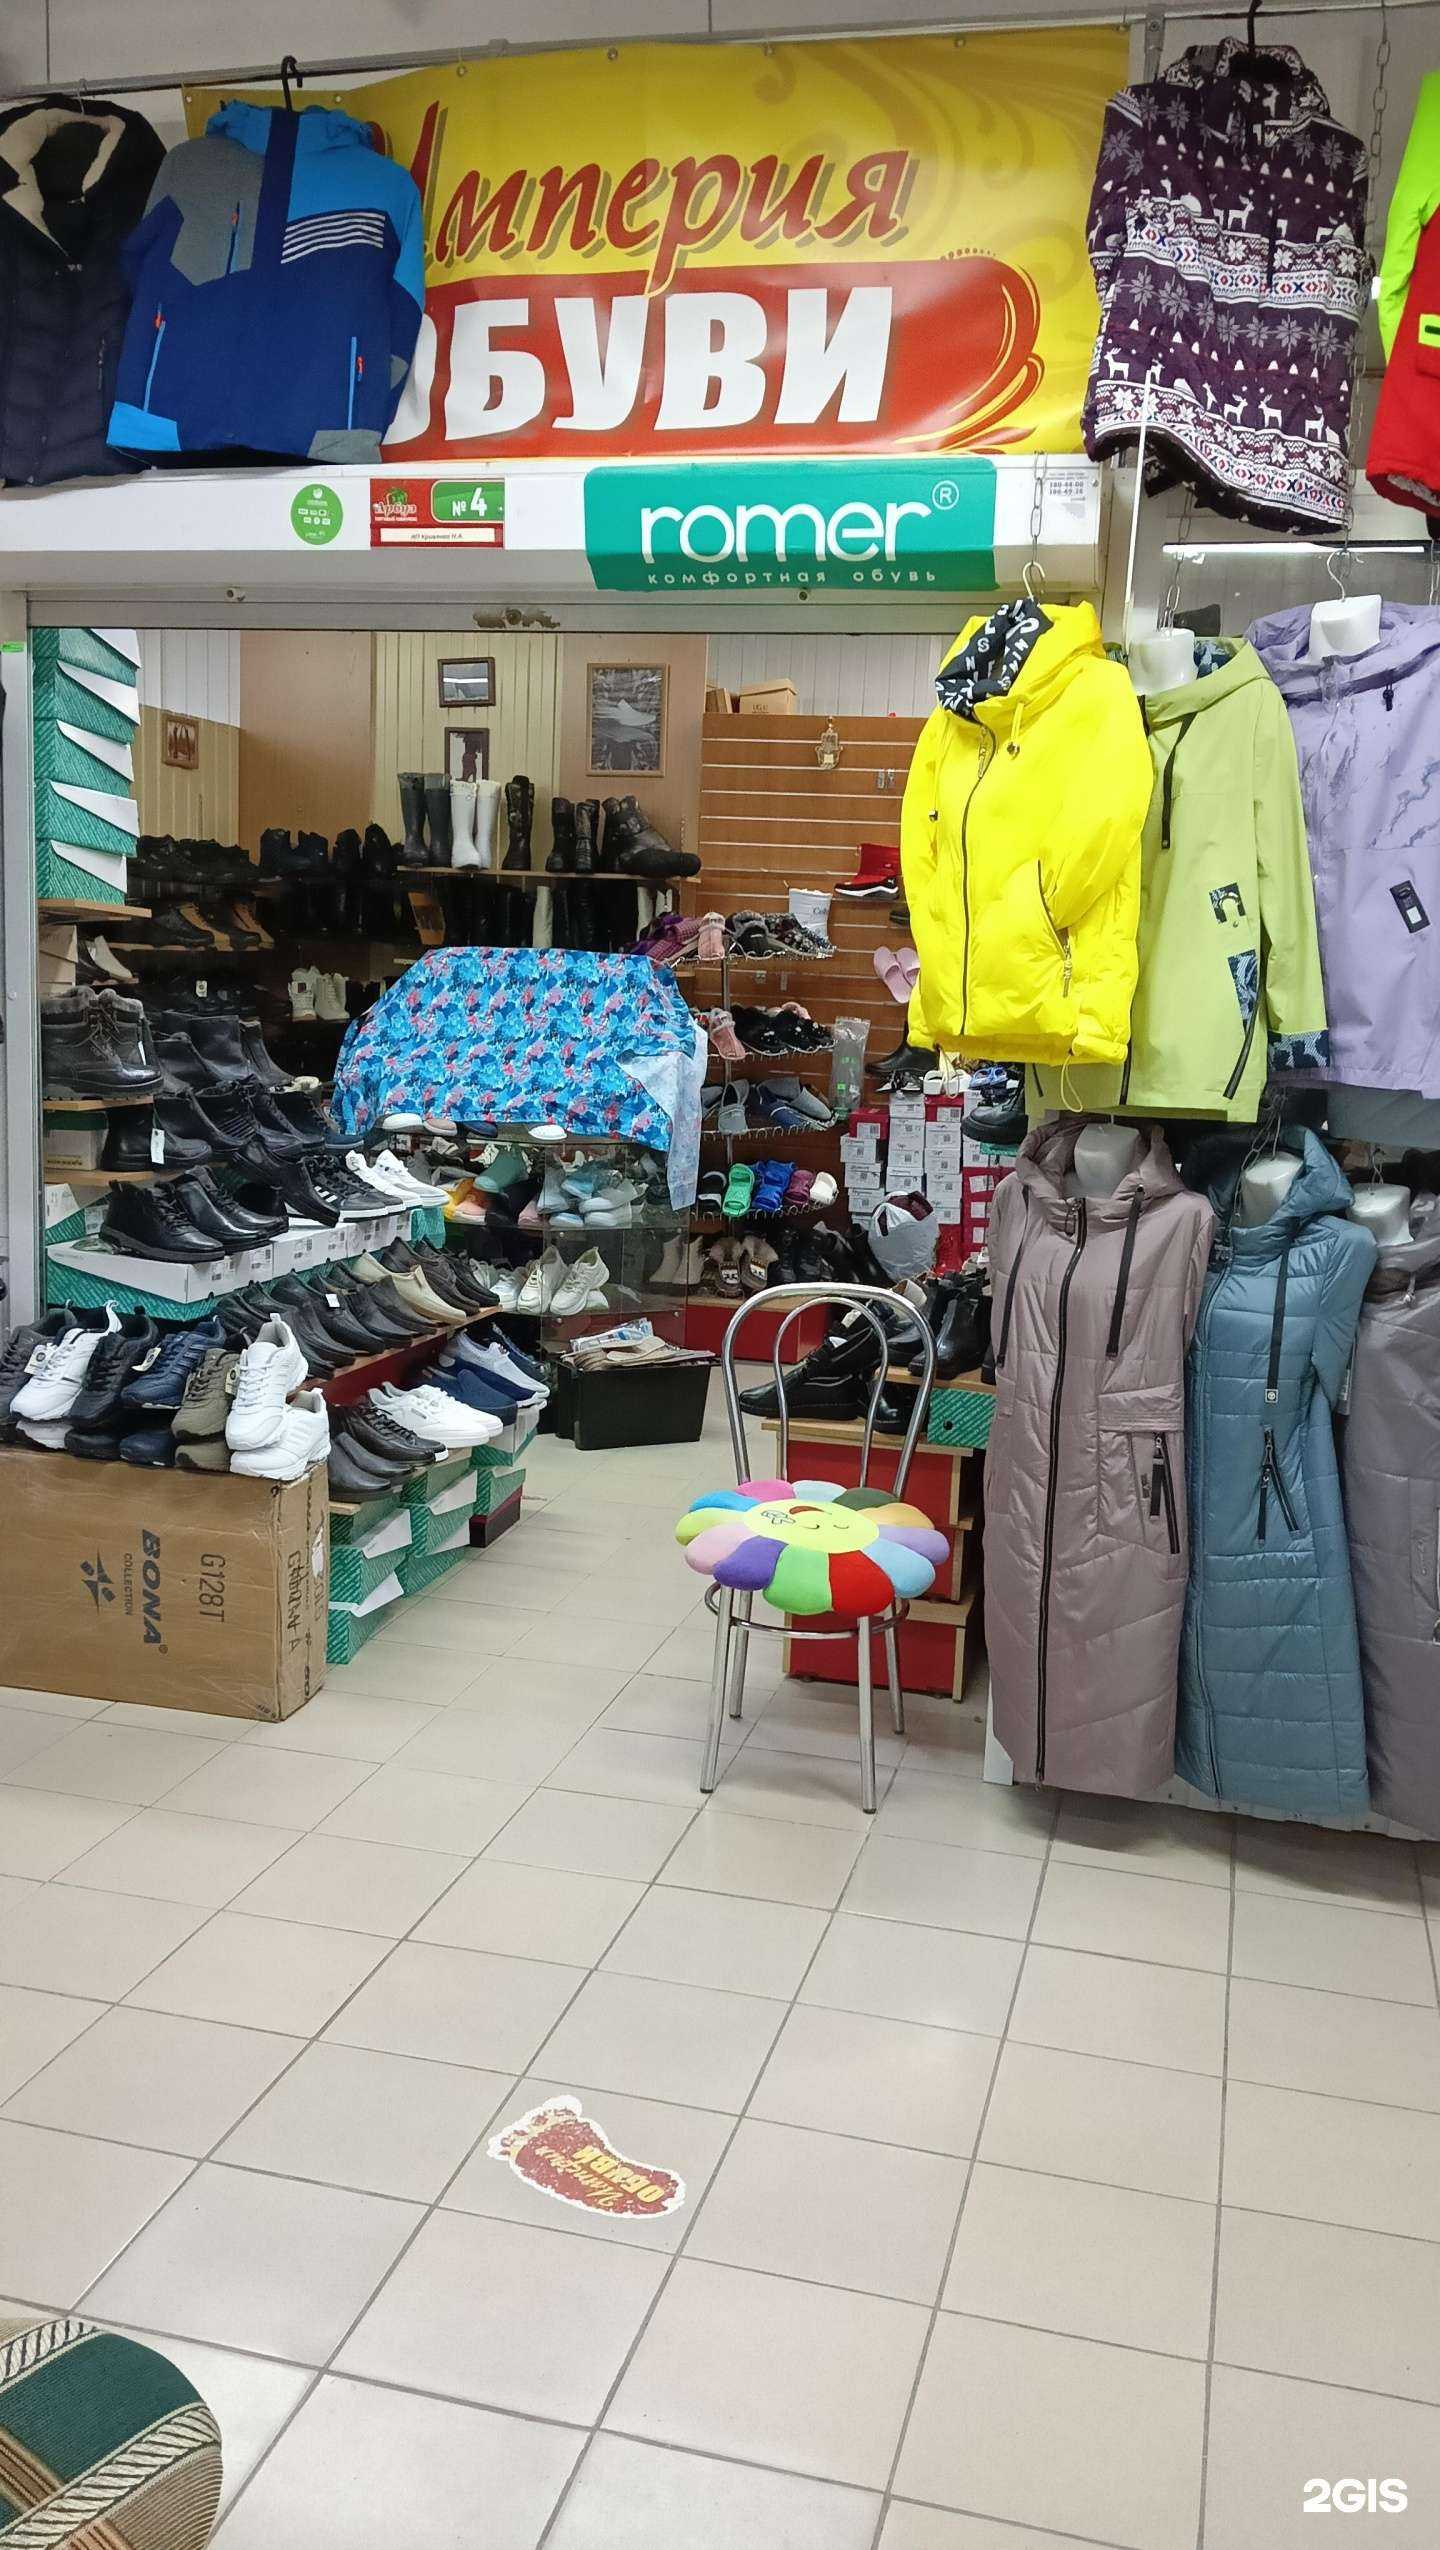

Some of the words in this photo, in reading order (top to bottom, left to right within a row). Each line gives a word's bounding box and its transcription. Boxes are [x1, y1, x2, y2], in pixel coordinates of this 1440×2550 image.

[647, 569, 826, 585] комфортная
[853, 568, 936, 584] обувь
[123, 1552, 133, 1616] COLLECTION
[199, 1552, 226, 1623] G128T
